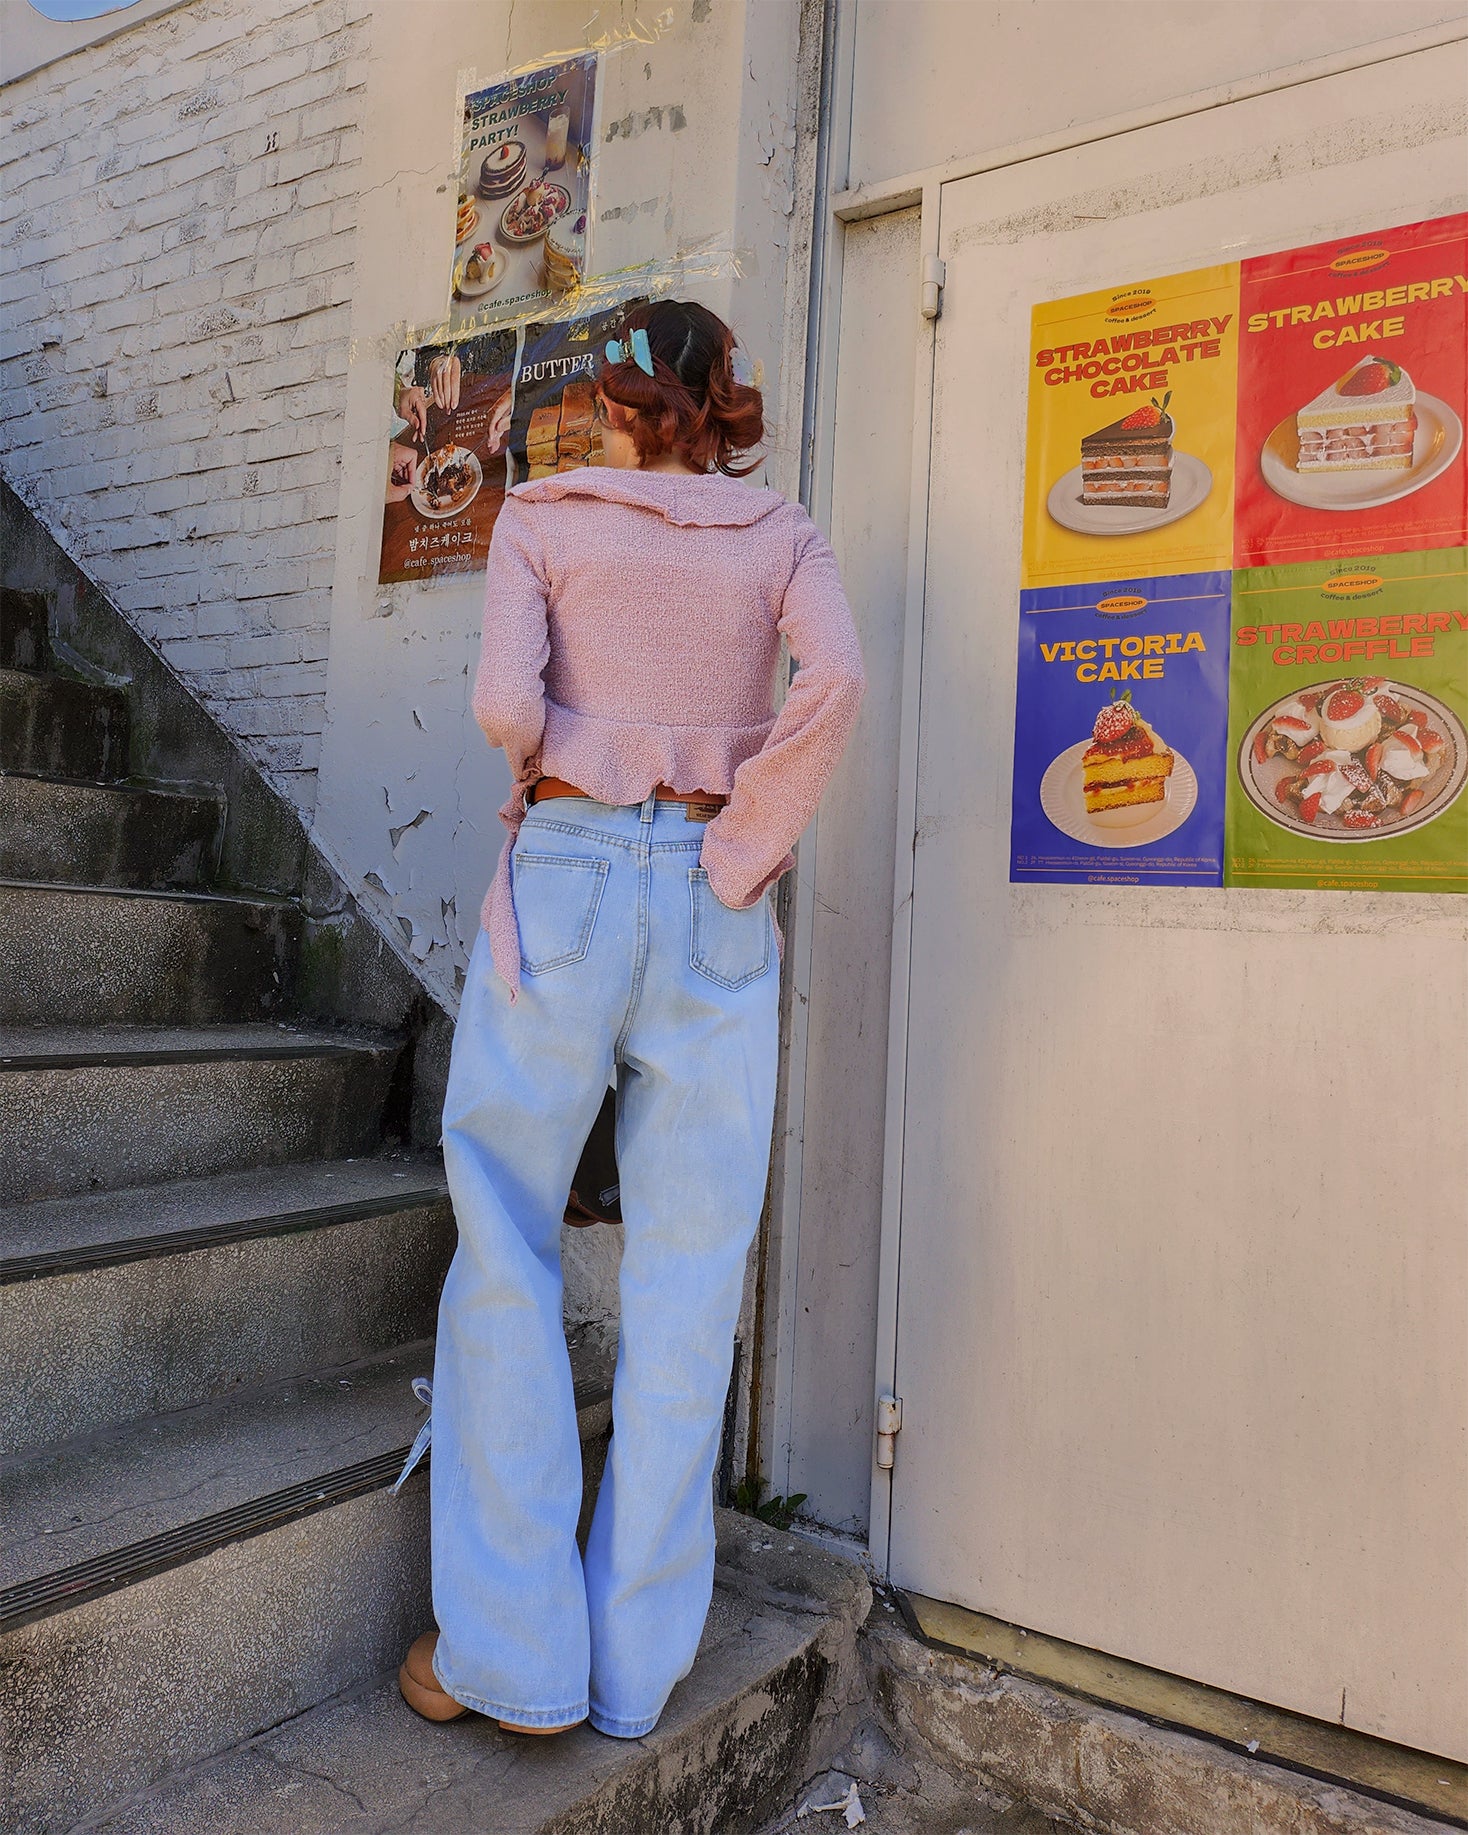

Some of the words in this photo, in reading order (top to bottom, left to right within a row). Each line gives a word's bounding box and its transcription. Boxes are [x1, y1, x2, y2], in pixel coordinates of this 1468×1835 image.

[471, 76, 557, 112] SPACESHOP
[471, 89, 569, 131] STRAWBERRY
[469, 124, 519, 152] PARTY!
[1335, 253, 1385, 267] SPACESHOP
[478, 290, 553, 312] @cafe.spaceshop
[1110, 300, 1153, 314] SPACESHOP
[1112, 291, 1132, 302] Since
[1130, 308, 1157, 321] dessert
[1036, 313, 1233, 368] STRAWBERRY
[1313, 316, 1405, 350] CAKE
[520, 353, 595, 383] BUTTER
[1044, 338, 1221, 386] CHOCOLATE
[1090, 369, 1168, 399] CAKE
[409, 532, 473, 552] 밤치즈케이크
[1327, 579, 1378, 588] SPACESHOP
[1352, 588, 1383, 600] dessert
[1101, 600, 1143, 608] SPACESHOP
[1040, 632, 1206, 662] VICTORIA
[1272, 636, 1435, 666] CROFFLE
[1076, 658, 1165, 683] CAKE
